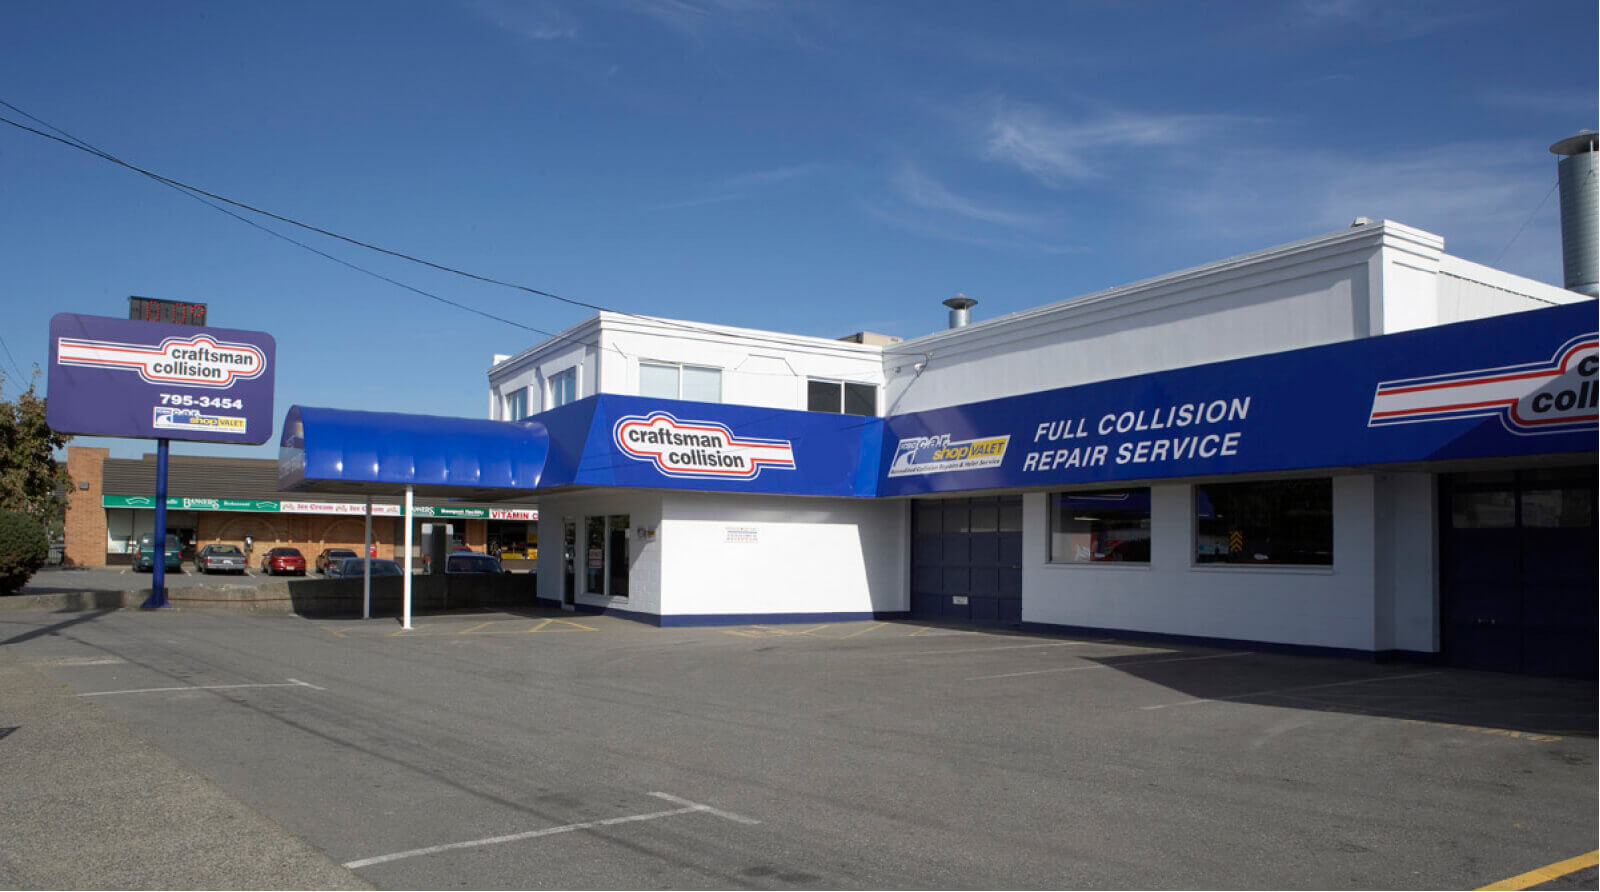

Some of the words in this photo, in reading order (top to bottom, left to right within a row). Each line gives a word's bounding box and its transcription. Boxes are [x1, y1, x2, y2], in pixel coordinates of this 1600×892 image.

[172, 347, 253, 366] craftsman
[153, 361, 221, 378] collision
[160, 394, 243, 410] 795-3454
[190, 416, 218, 425] shop
[1034, 418, 1088, 443] FULL
[1097, 396, 1251, 436] COLLISION
[628, 427, 722, 449] craftsman
[668, 448, 745, 468] collision
[932, 446, 968, 461] shop
[970, 441, 1005, 455] VALET
[1022, 444, 1108, 472] REPAIR
[1115, 431, 1242, 465] SERVICE
[492, 511, 529, 520] VITAMIN
